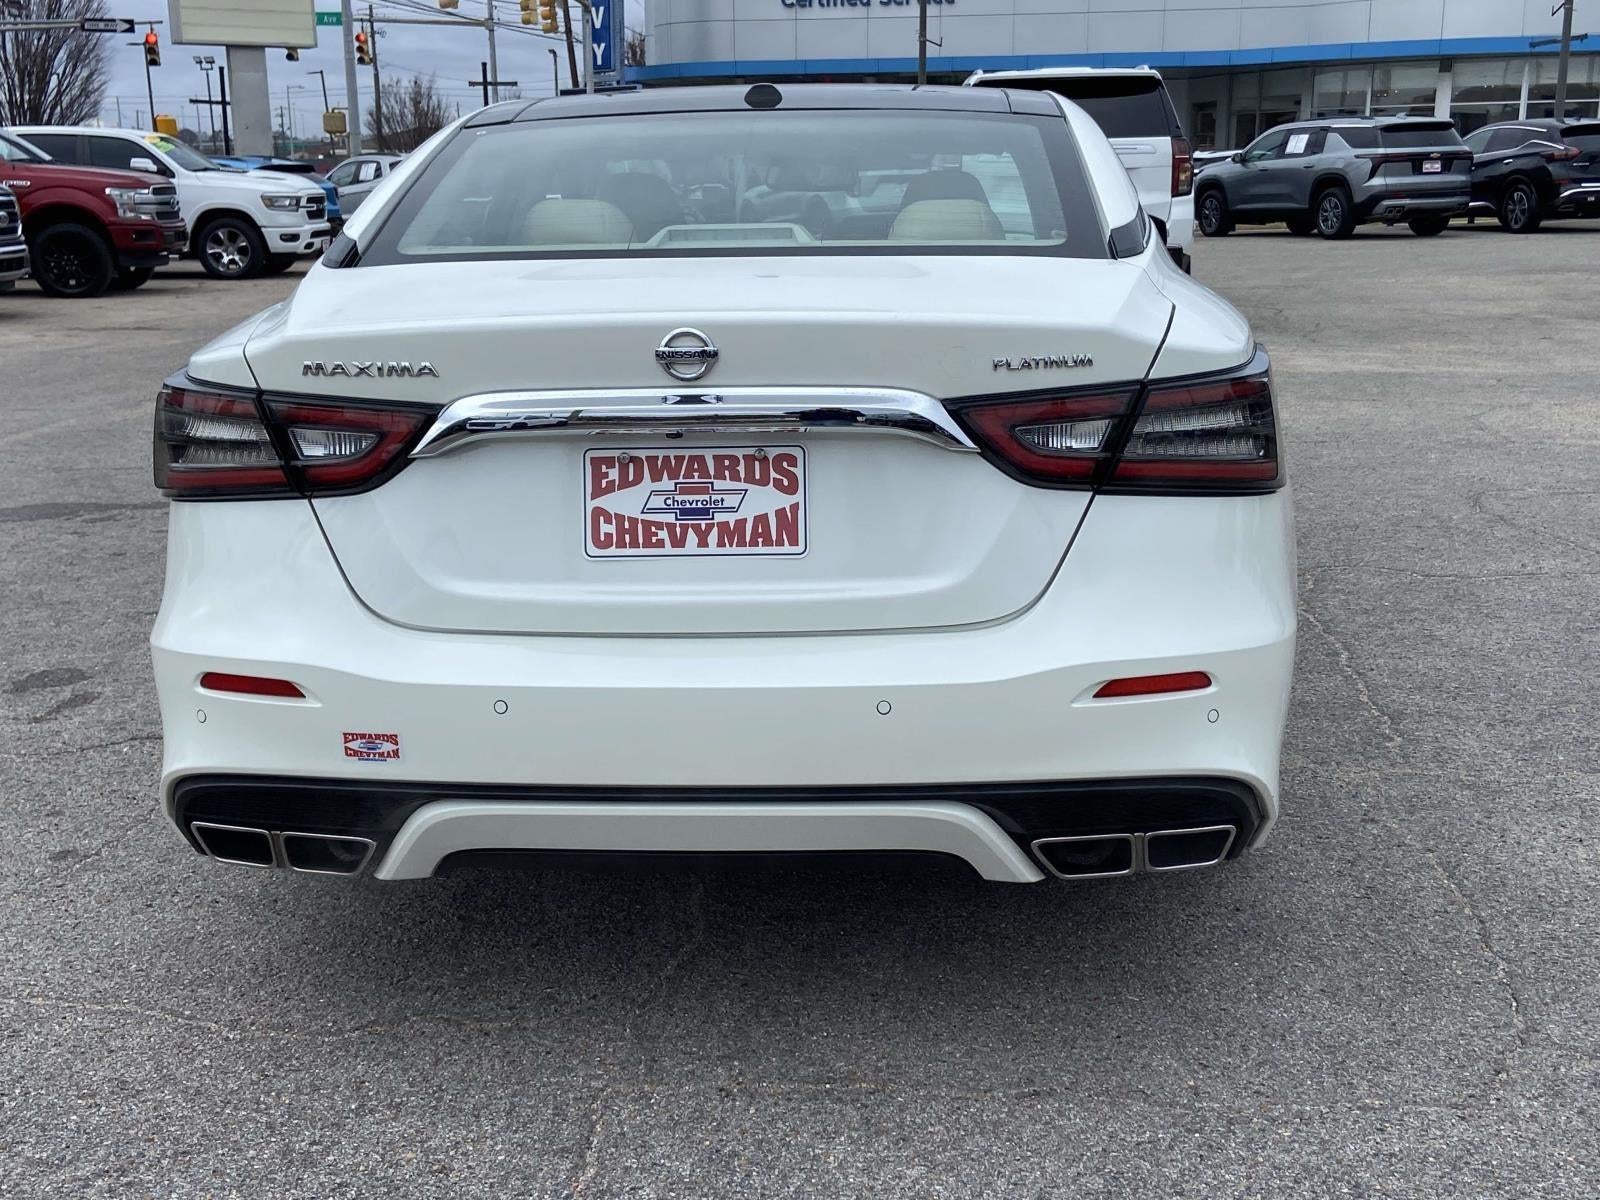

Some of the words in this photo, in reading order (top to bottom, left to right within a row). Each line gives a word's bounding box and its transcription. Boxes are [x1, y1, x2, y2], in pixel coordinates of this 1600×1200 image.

[323, 15, 337, 24] Ave
[661, 350, 712, 359] NISSAN
[302, 360, 440, 377] MAXIMA
[992, 353, 1094, 371] PLATINUM
[590, 452, 800, 501] EDWARDS
[663, 496, 725, 508] Chevrolet
[590, 502, 800, 550] CHEVYMAN
[342, 732, 399, 746] EDWARDS
[344, 746, 401, 759] CHEVYMAN
